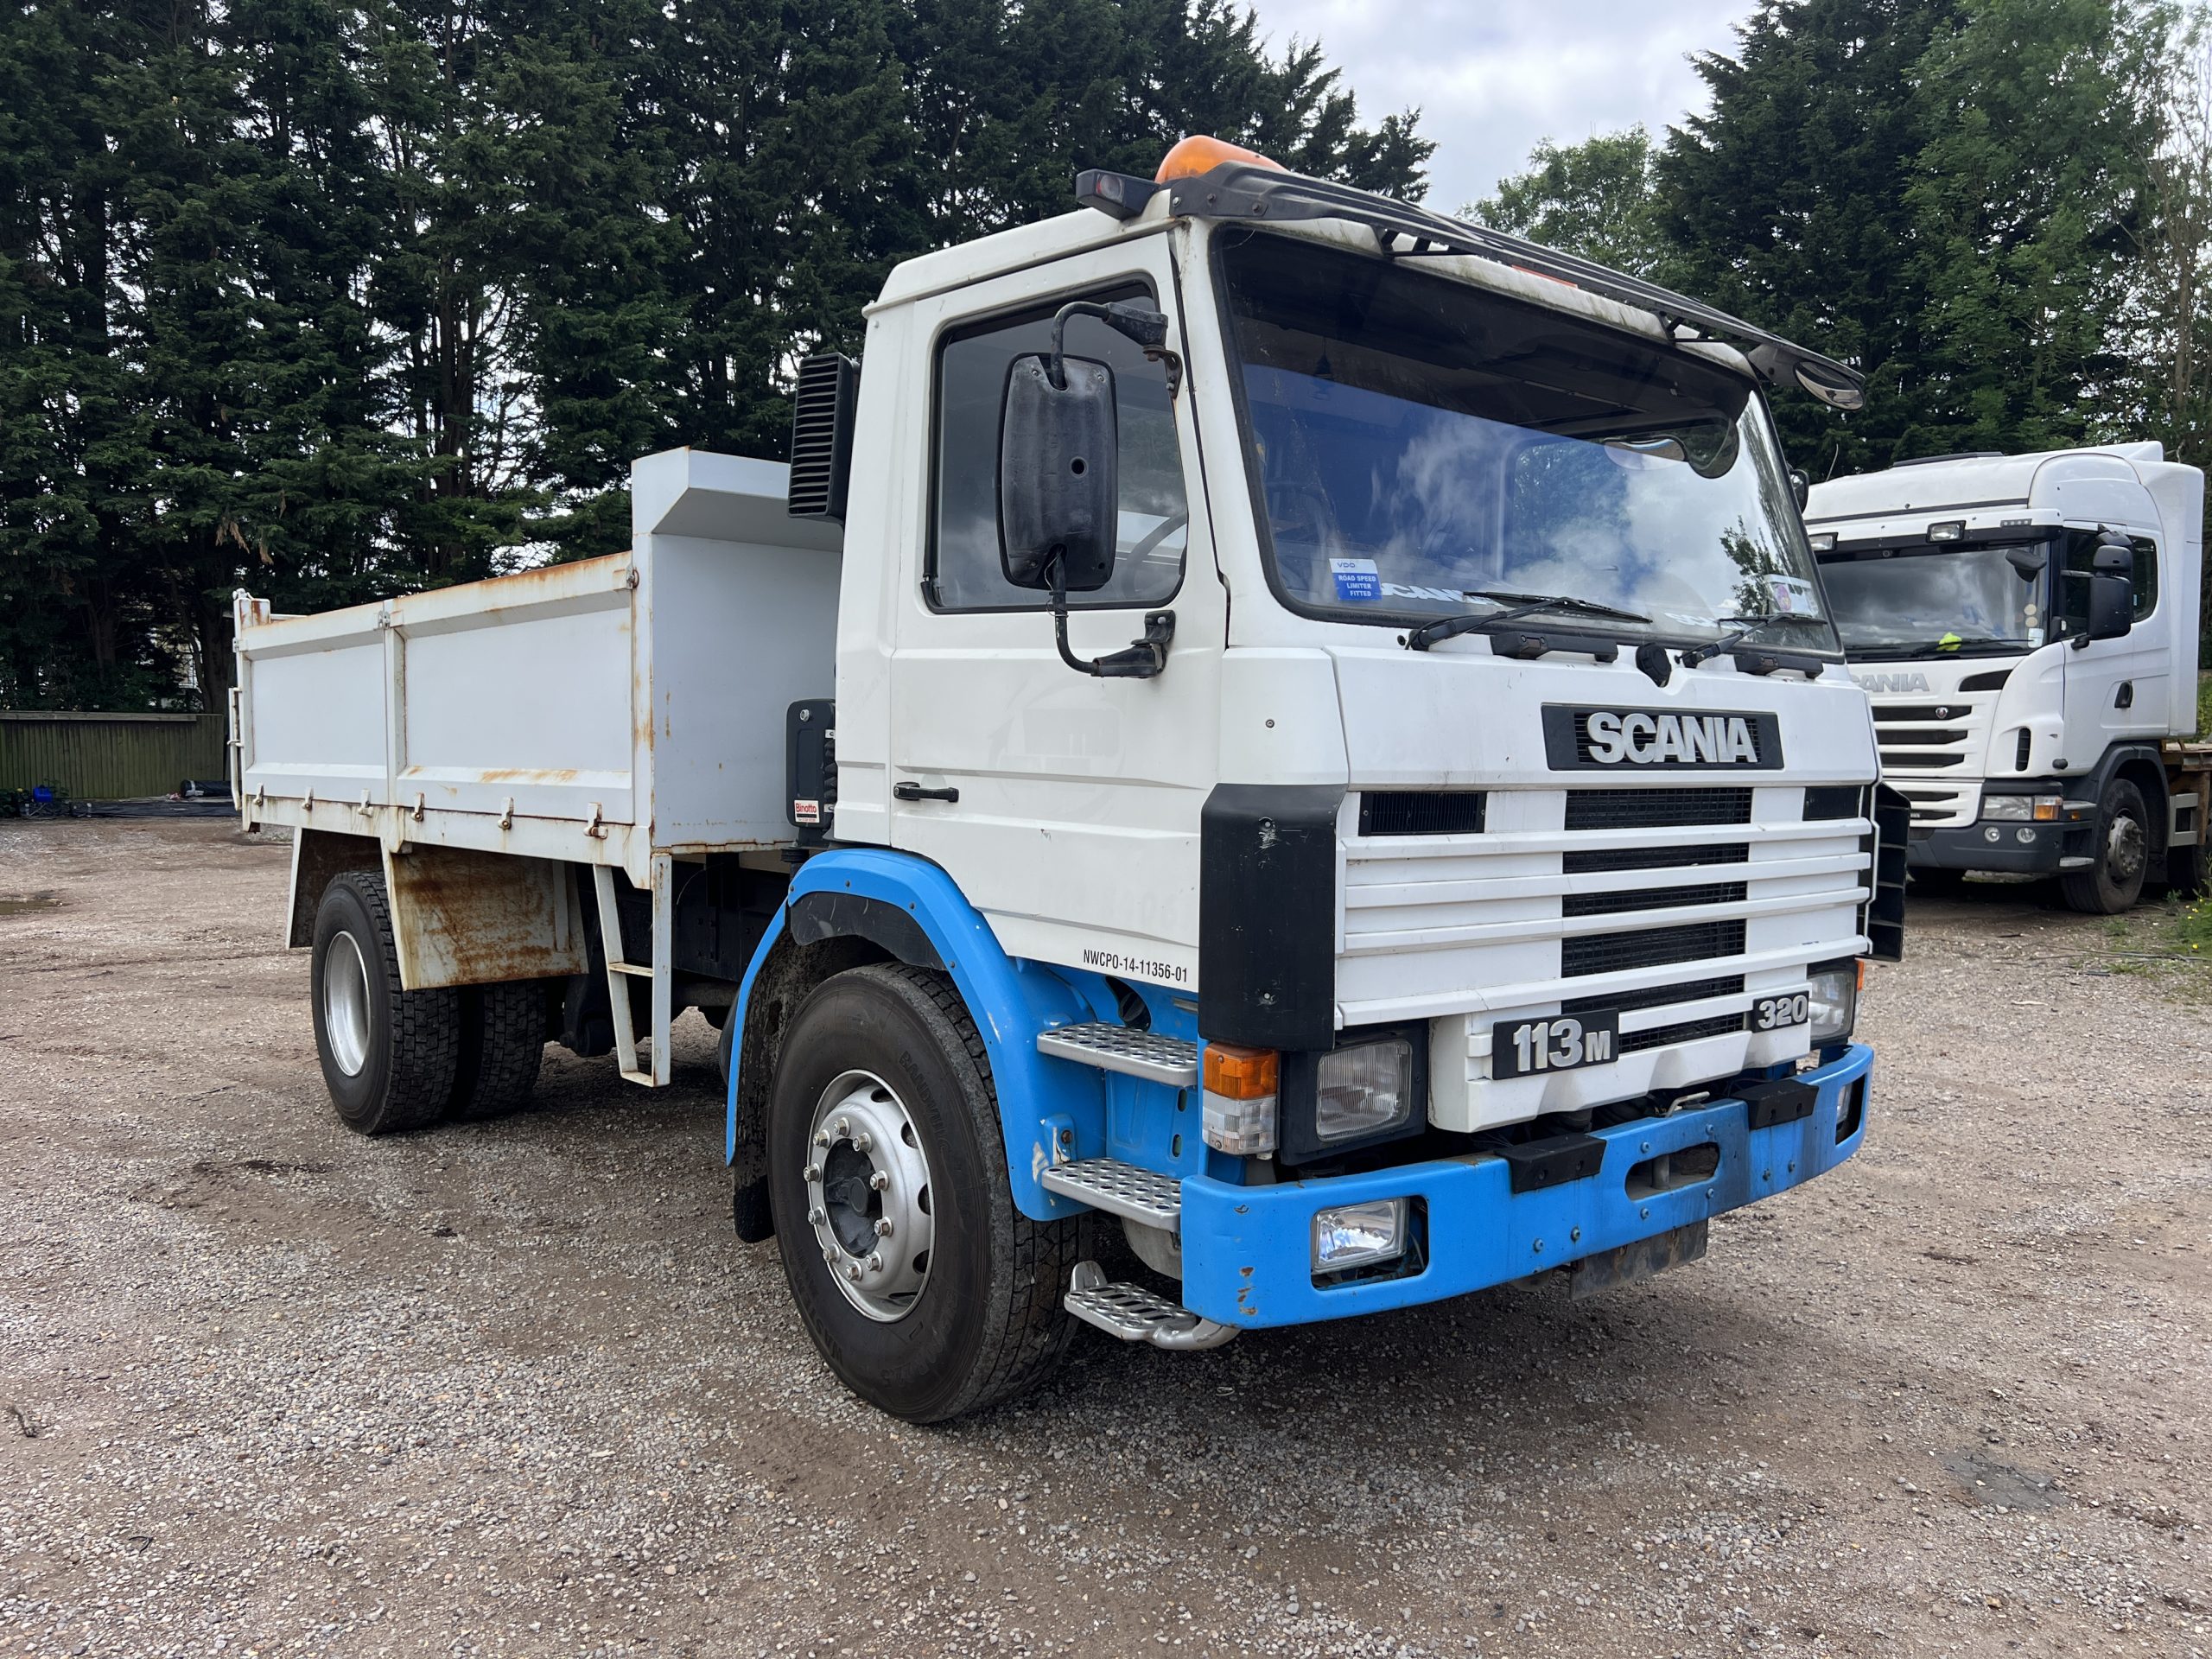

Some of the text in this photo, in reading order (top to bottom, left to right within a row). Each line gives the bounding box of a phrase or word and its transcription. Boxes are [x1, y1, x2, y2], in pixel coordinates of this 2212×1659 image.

[1587, 711, 1758, 764] SCANIA
[796, 803, 817, 813] Binotto
[1758, 995, 1808, 1029] 320
